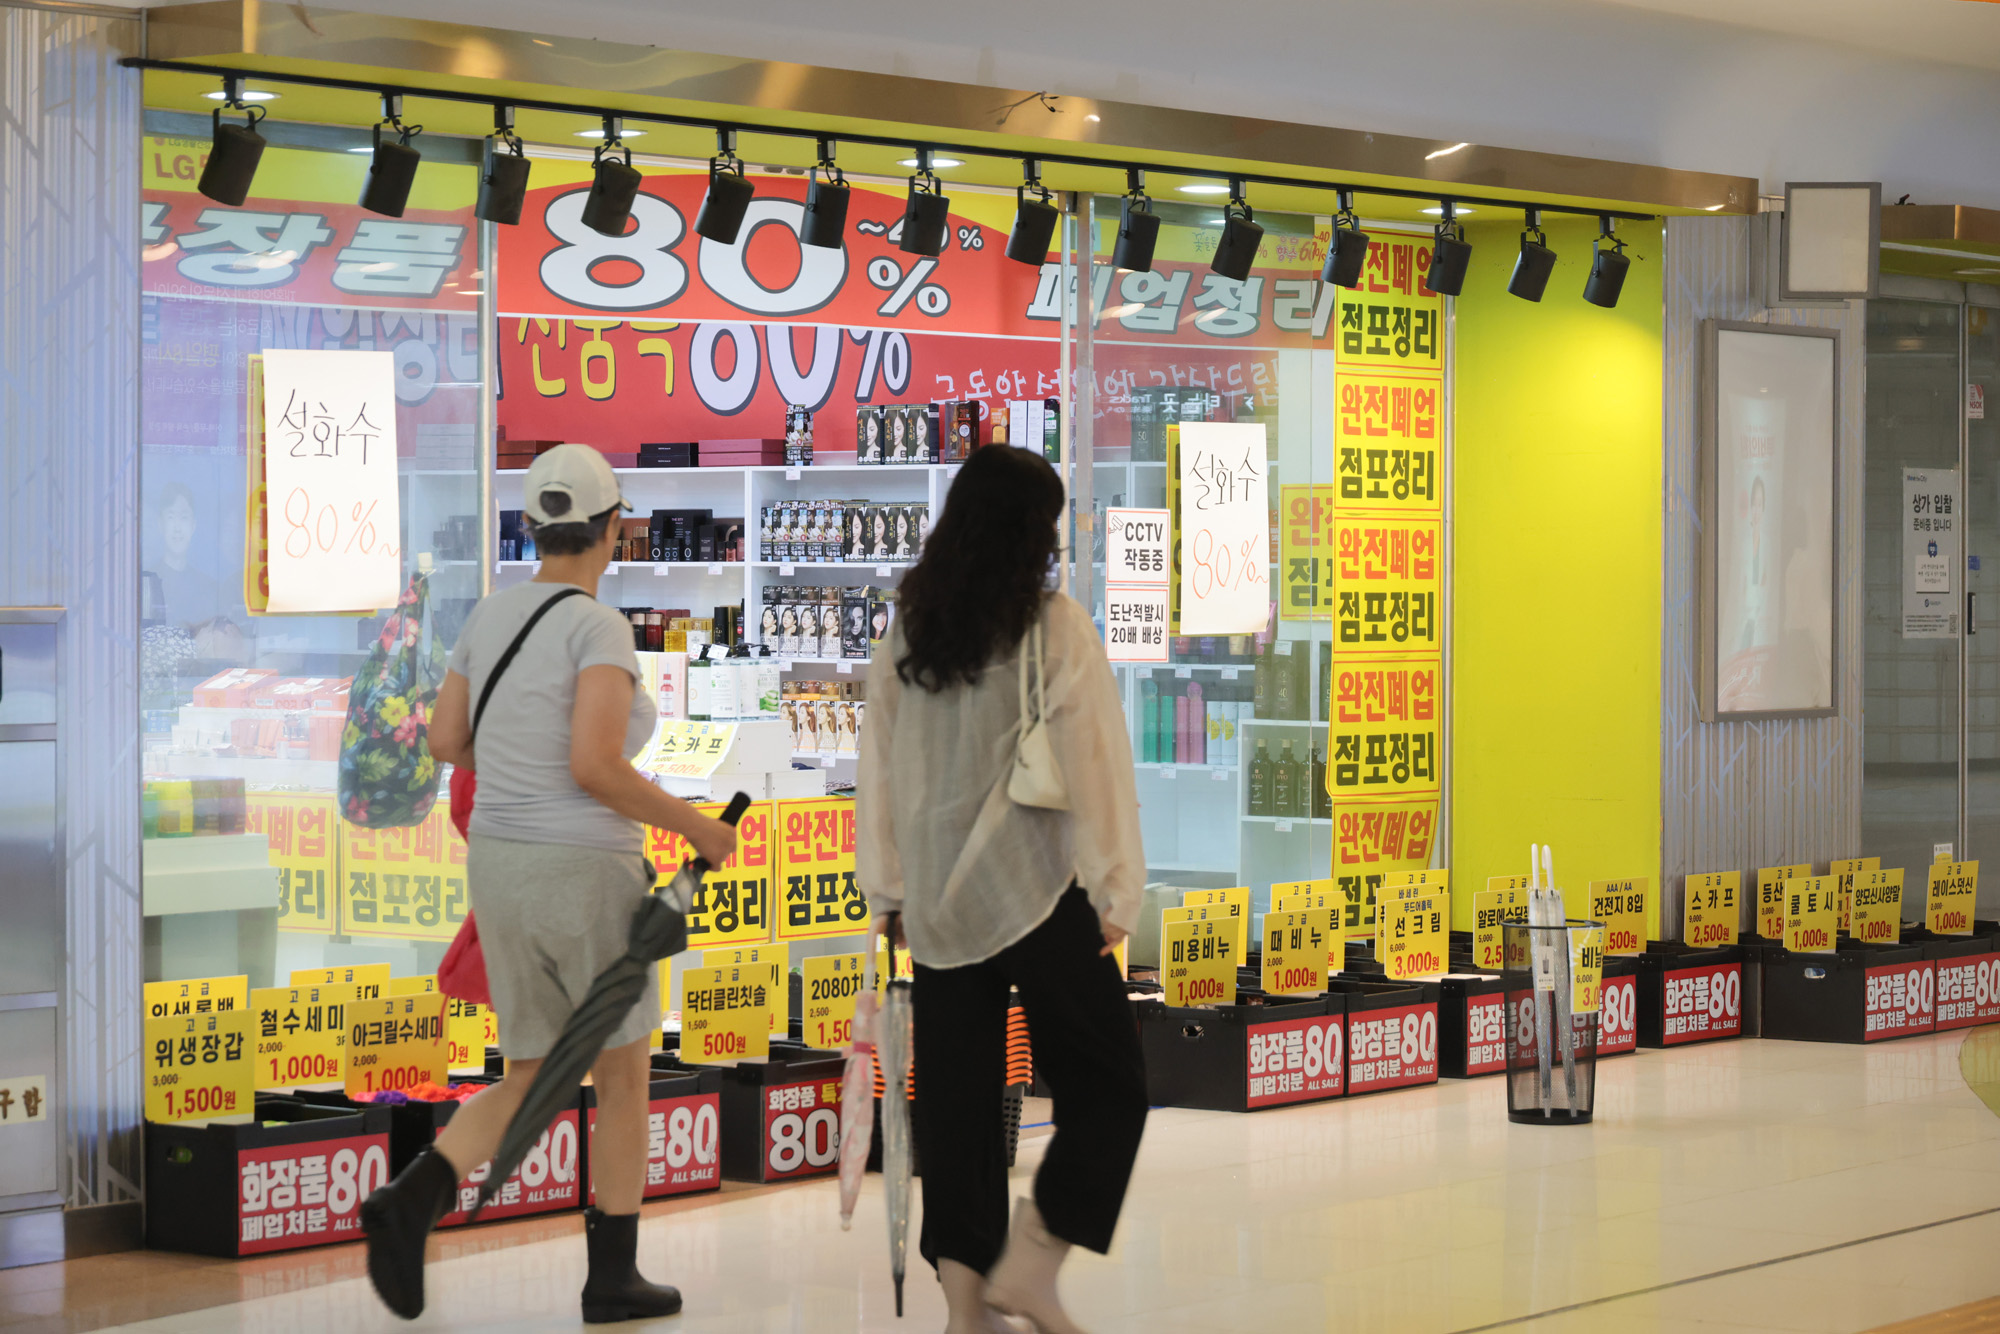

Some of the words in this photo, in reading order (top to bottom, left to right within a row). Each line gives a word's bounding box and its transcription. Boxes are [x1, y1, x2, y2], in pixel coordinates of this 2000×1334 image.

[538, 187, 850, 316] 80
[1344, 242, 1437, 298] 전폐업
[1026, 261, 1335, 340] 폐업정리
[1341, 303, 1437, 360] 점포정리
[1340, 382, 1435, 439] 완전폐업
[277, 389, 382, 466] 설화수
[1188, 447, 1260, 511] 설화수
[1339, 448, 1435, 501] 점포정리
[1912, 494, 1931, 514] 상가
[1933, 494, 1952, 514] 입찰
[1124, 521, 1164, 543] CCTV
[1913, 517, 1931, 531] 준비중
[1933, 518, 1952, 532] 입니다
[1124, 548, 1164, 572] 작동중
[1339, 528, 1435, 580] 완전폐업
[1109, 603, 1165, 623] 도난적발시
[1338, 591, 1435, 643] 점포정리
[1111, 627, 1138, 644] 20배
[1142, 626, 1163, 645] 배상
[1337, 669, 1434, 723] 완전폐업
[686, 724, 708, 735] 고급
[662, 735, 723, 753] 스카프
[1334, 732, 1435, 787] 점포정리
[245, 805, 326, 857] 폐업
[786, 809, 856, 863] 완전폐
[1339, 810, 1432, 865] 완전폐업
[651, 814, 766, 874] 완업
[1606, 884, 1618, 893] AAA
[1624, 881, 1633, 891] AA
[1762, 882, 1784, 904] 등산
[1855, 885, 1900, 907] 양모신사양말
[1932, 877, 1973, 898] 레이스덧신
[687, 878, 767, 934] 포정리
[786, 871, 868, 927] 점포정
[1594, 896, 1624, 917] 건전지
[1627, 894, 1643, 913] 8입
[1691, 888, 1734, 911] 스카프
[1791, 891, 1833, 916] 쿨토시
[1192, 922, 1213, 936] 고급
[1288, 914, 1307, 926] 고급
[1395, 912, 1441, 939] 선크림
[1859, 920, 1892, 943] 1,000원
[1935, 911, 1967, 932] 1,000원
[1271, 927, 1322, 953] 때비누
[1478, 933, 1493, 943] 5,000
[1605, 931, 1638, 954] ,500원
[1693, 924, 1730, 945] 2,500원
[1793, 928, 1828, 951] 1,000원
[734, 950, 758, 963] 고급
[1172, 936, 1230, 963] 미용비누
[1484, 944, 1525, 965] 2,500원
[1170, 968, 1187, 978] 2,000
[1268, 957, 1283, 968] 2,000
[1395, 952, 1440, 979] 3,000원
[326, 969, 353, 984] 고급
[714, 969, 739, 983] 고급
[1273, 967, 1317, 993] 1,000원
[1937, 964, 1976, 1001] 화장품
[180, 982, 210, 997] 고급
[290, 988, 320, 1003] 고급
[687, 984, 766, 1013] 닥터클린칫솔
[1178, 978, 1224, 1003] 1,000원
[1665, 976, 1709, 1015] 화장품
[1866, 972, 1906, 1011] 화장품
[385, 999, 414, 1015] 고급
[810, 1007, 829, 1018] 2,500
[1937, 1001, 1976, 1022] 폐업처분
[1978, 1009, 1987, 1017] ALL
[1987, 1006, 2000, 1016] SALE
[186, 1016, 217, 1033] 고급
[260, 1004, 344, 1037] 철수세미
[352, 1016, 444, 1047] 아크릴수세미
[687, 1020, 708, 1030] 1,500
[1665, 1012, 1709, 1035] 폐업처분
[1712, 1021, 1722, 1030] ALL
[1723, 1019, 1738, 1029] SALE
[1866, 1010, 1905, 1032] 폐업처분
[1908, 1018, 1918, 1026] ALL
[1918, 1016, 1932, 1025] SALE
[155, 1032, 244, 1068] 위생장갑
[258, 1042, 283, 1054] 2,000
[703, 1031, 746, 1057] 500원
[1350, 1018, 1401, 1061] 화장품
[1606, 1036, 1617, 1046] ALL
[1618, 1033, 1633, 1043] SALE
[353, 1054, 378, 1067] 2,000
[1250, 1029, 1304, 1075] 화장품
[152, 1074, 180, 1087] 3,000
[270, 1054, 338, 1084] 1,000원
[1350, 1058, 1401, 1084] 폐업처분
[1404, 1067, 1417, 1077] ALL
[1417, 1064, 1434, 1075] SALE
[1250, 1071, 1304, 1098] 폐업처분
[1307, 1080, 1321, 1091] ALL
[1321, 1078, 1339, 1089] SALE
[165, 1086, 236, 1119] 1,500원
[769, 1085, 816, 1112] 화장품
[821, 1082, 843, 1104] 특
[241, 1154, 329, 1213] 화장품
[671, 1170, 689, 1184] ALL
[690, 1167, 714, 1181] SALE
[527, 1190, 545, 1203] ALL
[547, 1186, 573, 1200] SALE
[241, 1207, 329, 1242] 폐업처분
[334, 1218, 352, 1232] ALL
